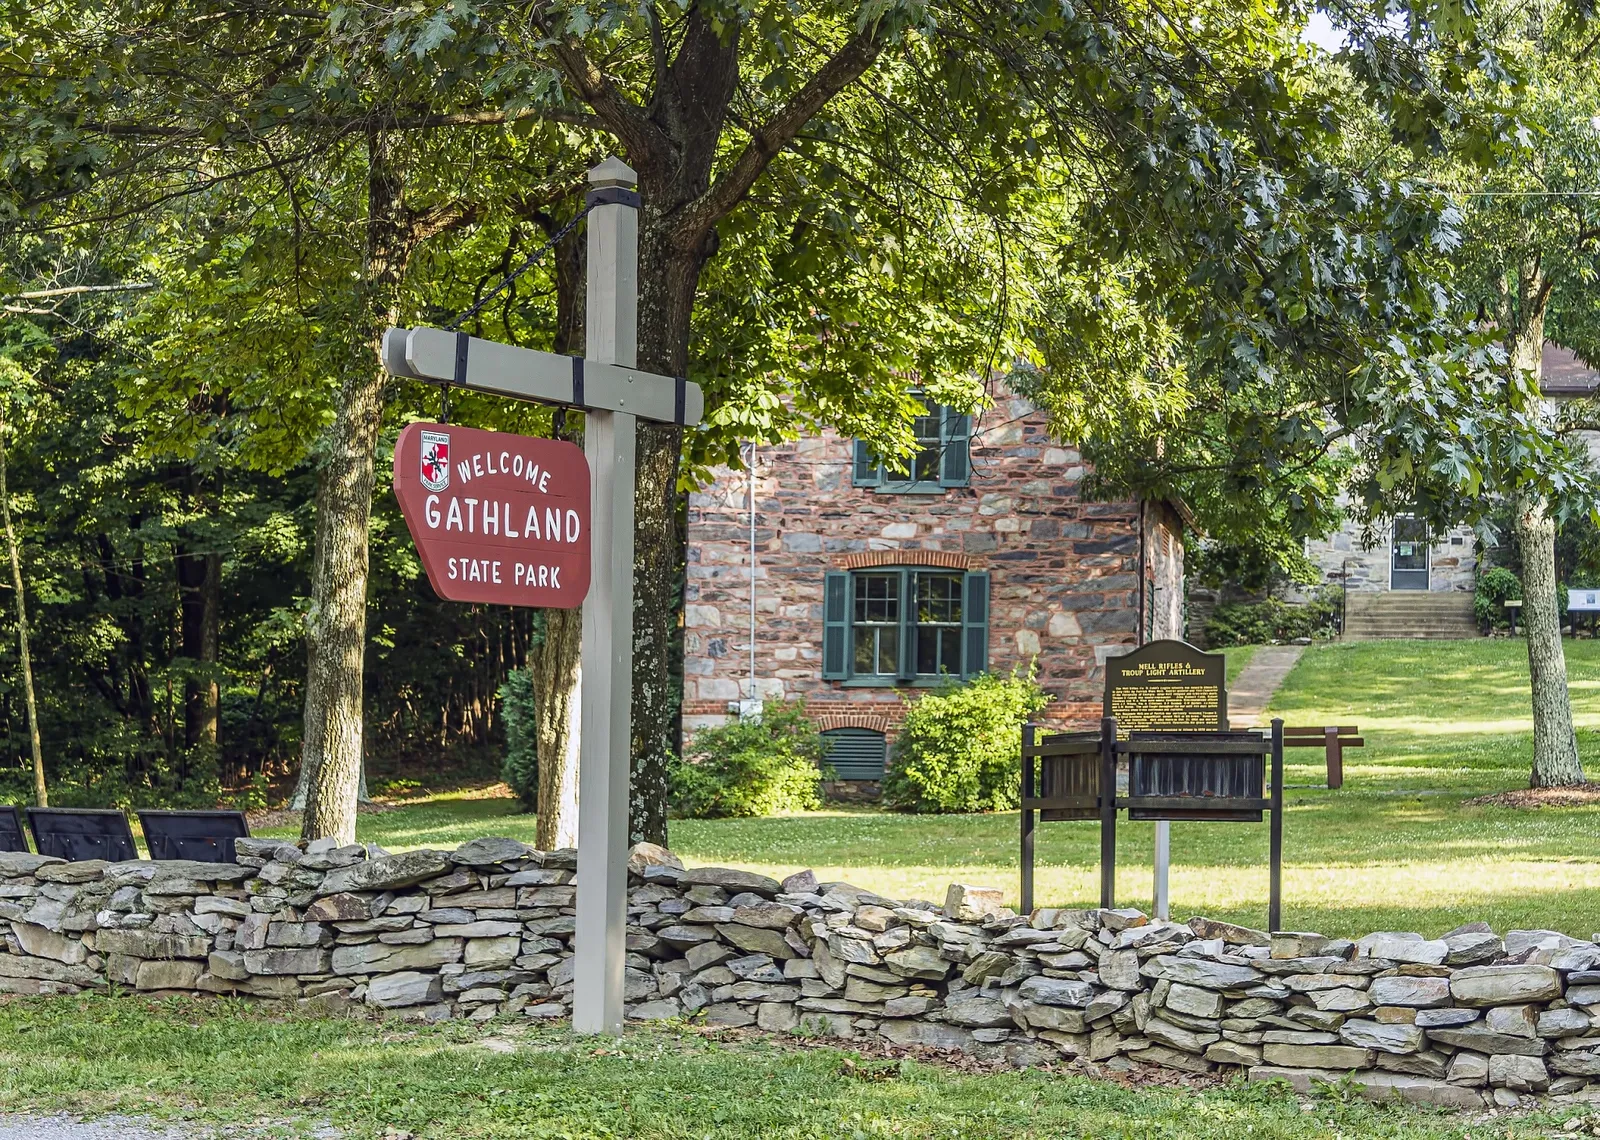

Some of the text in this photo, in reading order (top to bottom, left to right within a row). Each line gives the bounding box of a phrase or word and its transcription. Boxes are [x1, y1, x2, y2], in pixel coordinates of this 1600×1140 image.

[423, 435, 448, 443] MARYLAND
[457, 451, 552, 494] WELCOME
[425, 494, 581, 543] GATHLAND
[448, 557, 561, 589] STATE PARK
[1168, 668, 1206, 676] ARTILLERY
